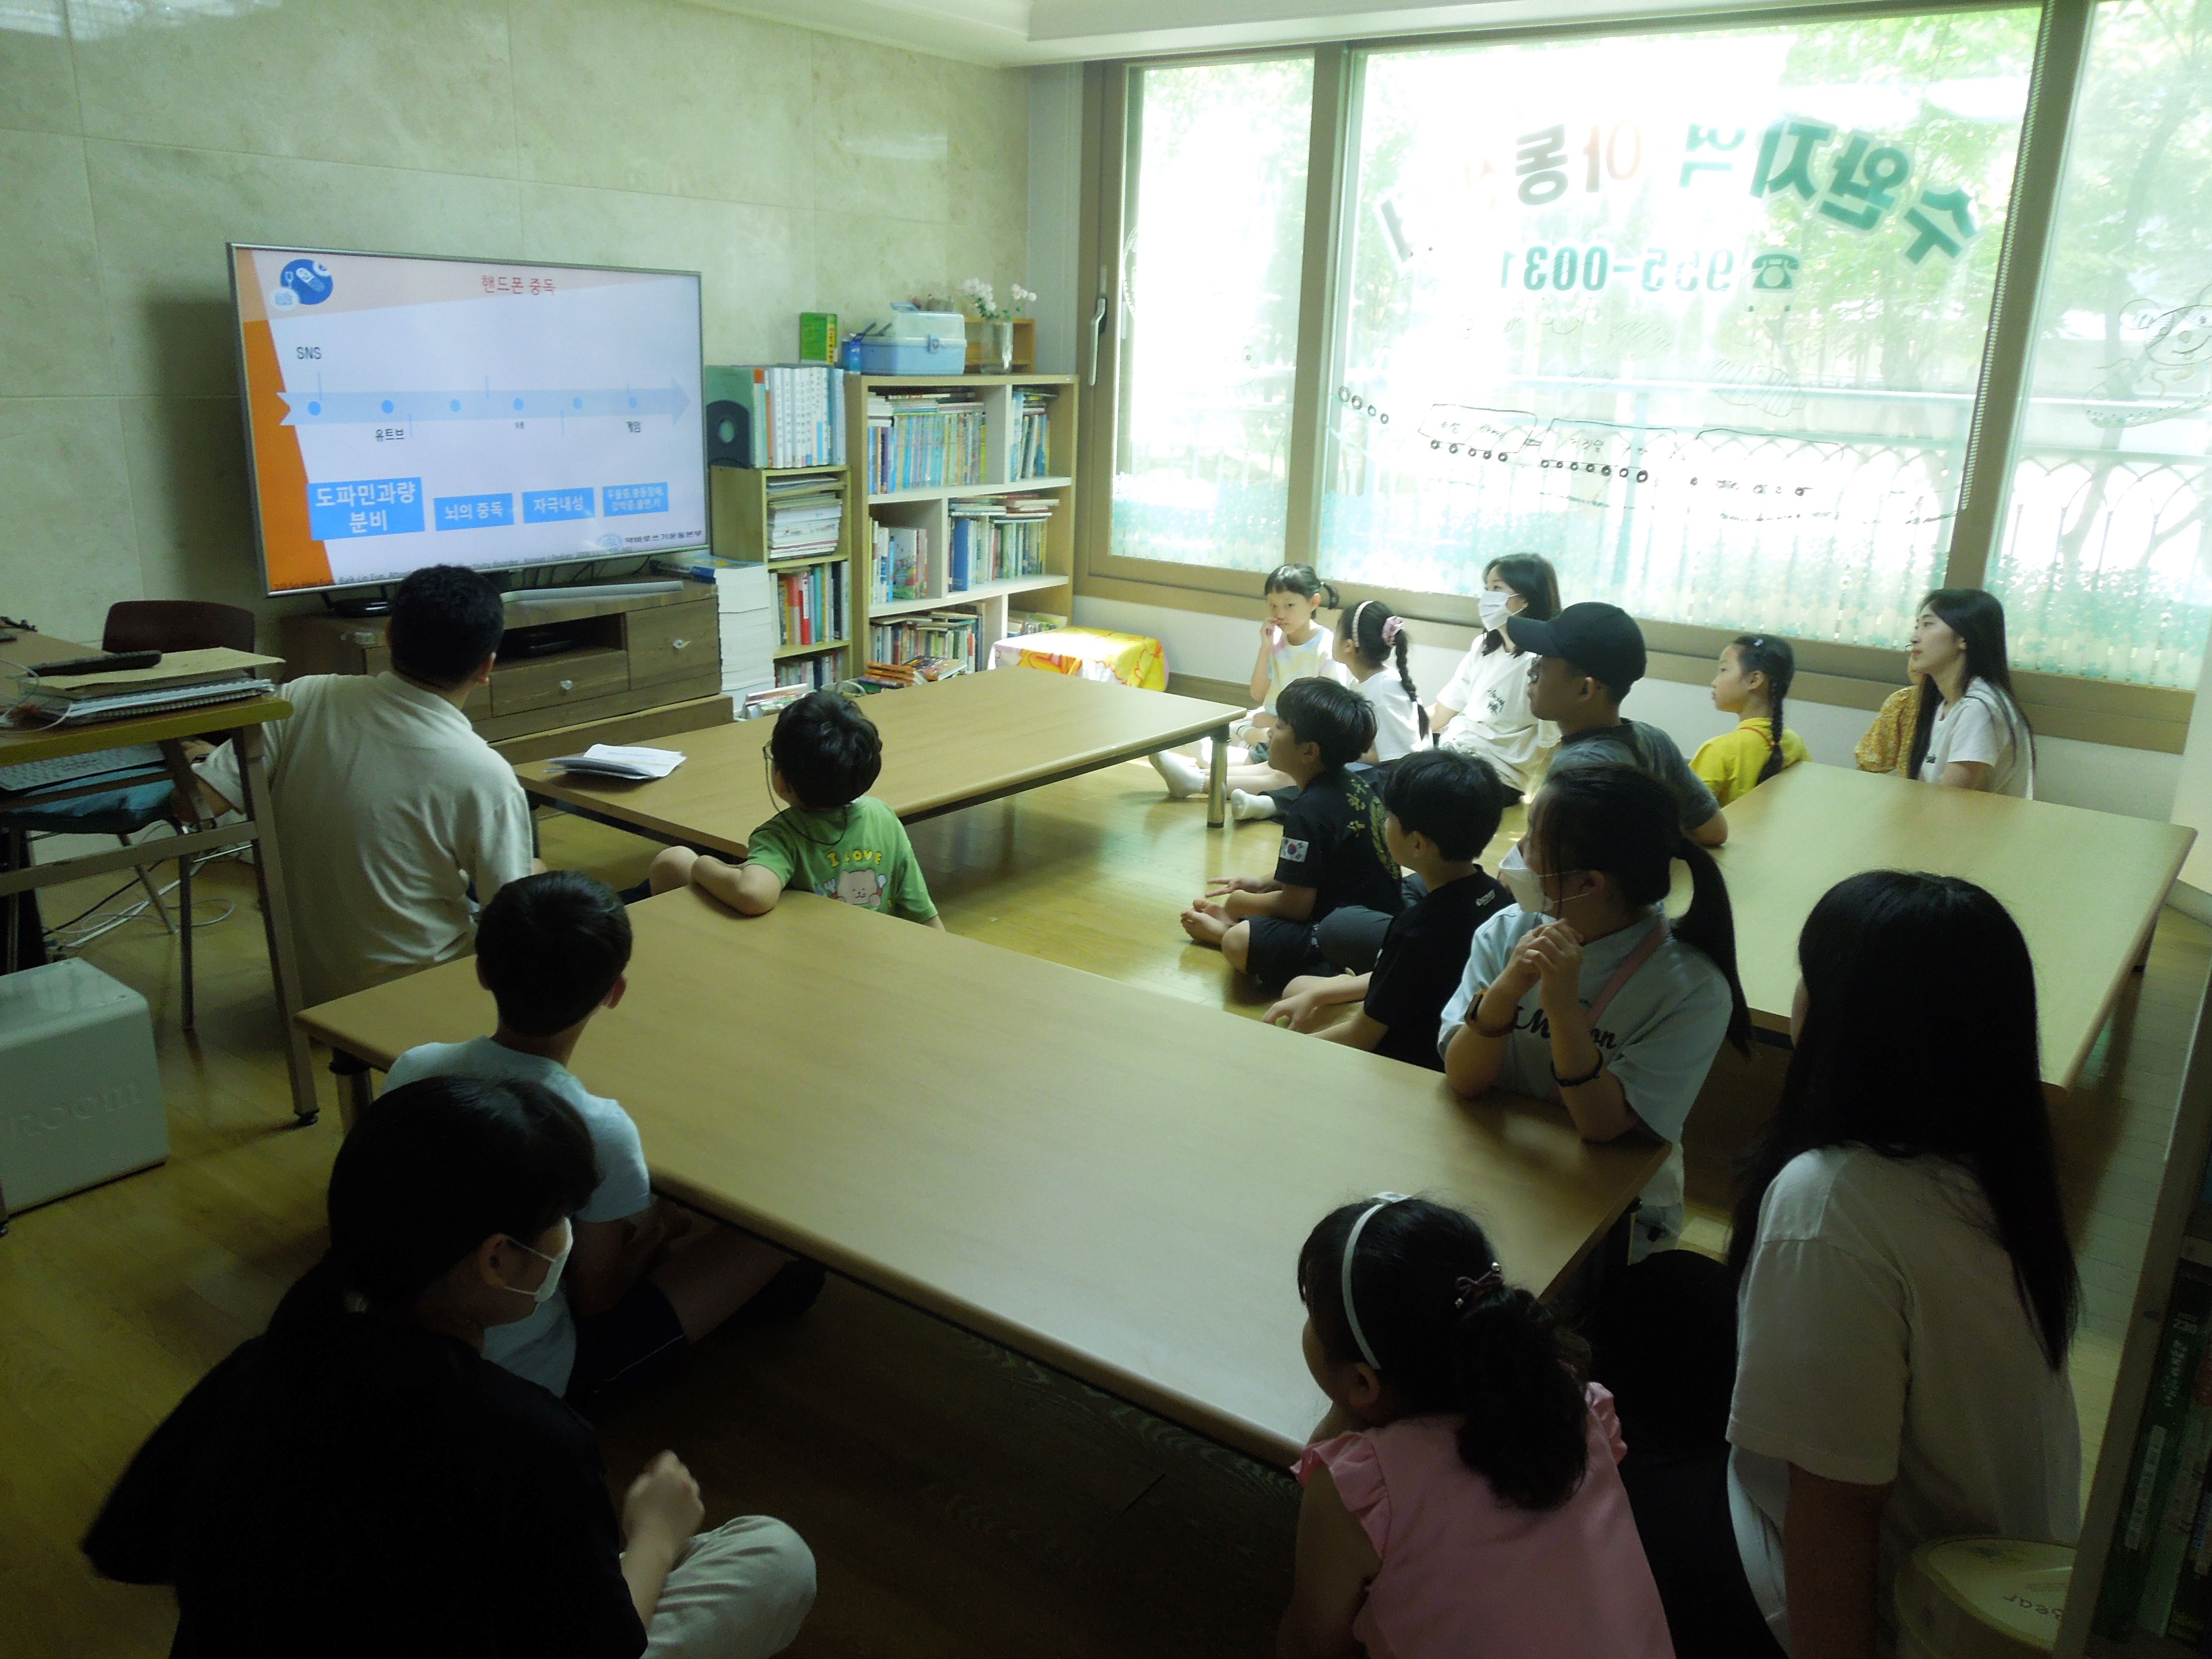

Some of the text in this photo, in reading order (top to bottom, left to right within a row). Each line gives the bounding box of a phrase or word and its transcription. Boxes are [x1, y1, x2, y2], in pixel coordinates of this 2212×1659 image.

[481, 275, 556, 297] 핸드폰 중독
[296, 346, 322, 360] SNS
[375, 428, 405, 442] 유트브
[315, 481, 416, 507] 도파민과량
[445, 501, 504, 521] 뇌의 중독
[533, 495, 584, 514] 자극내성
[349, 509, 388, 534] 분비
[826, 851, 840, 868] I
